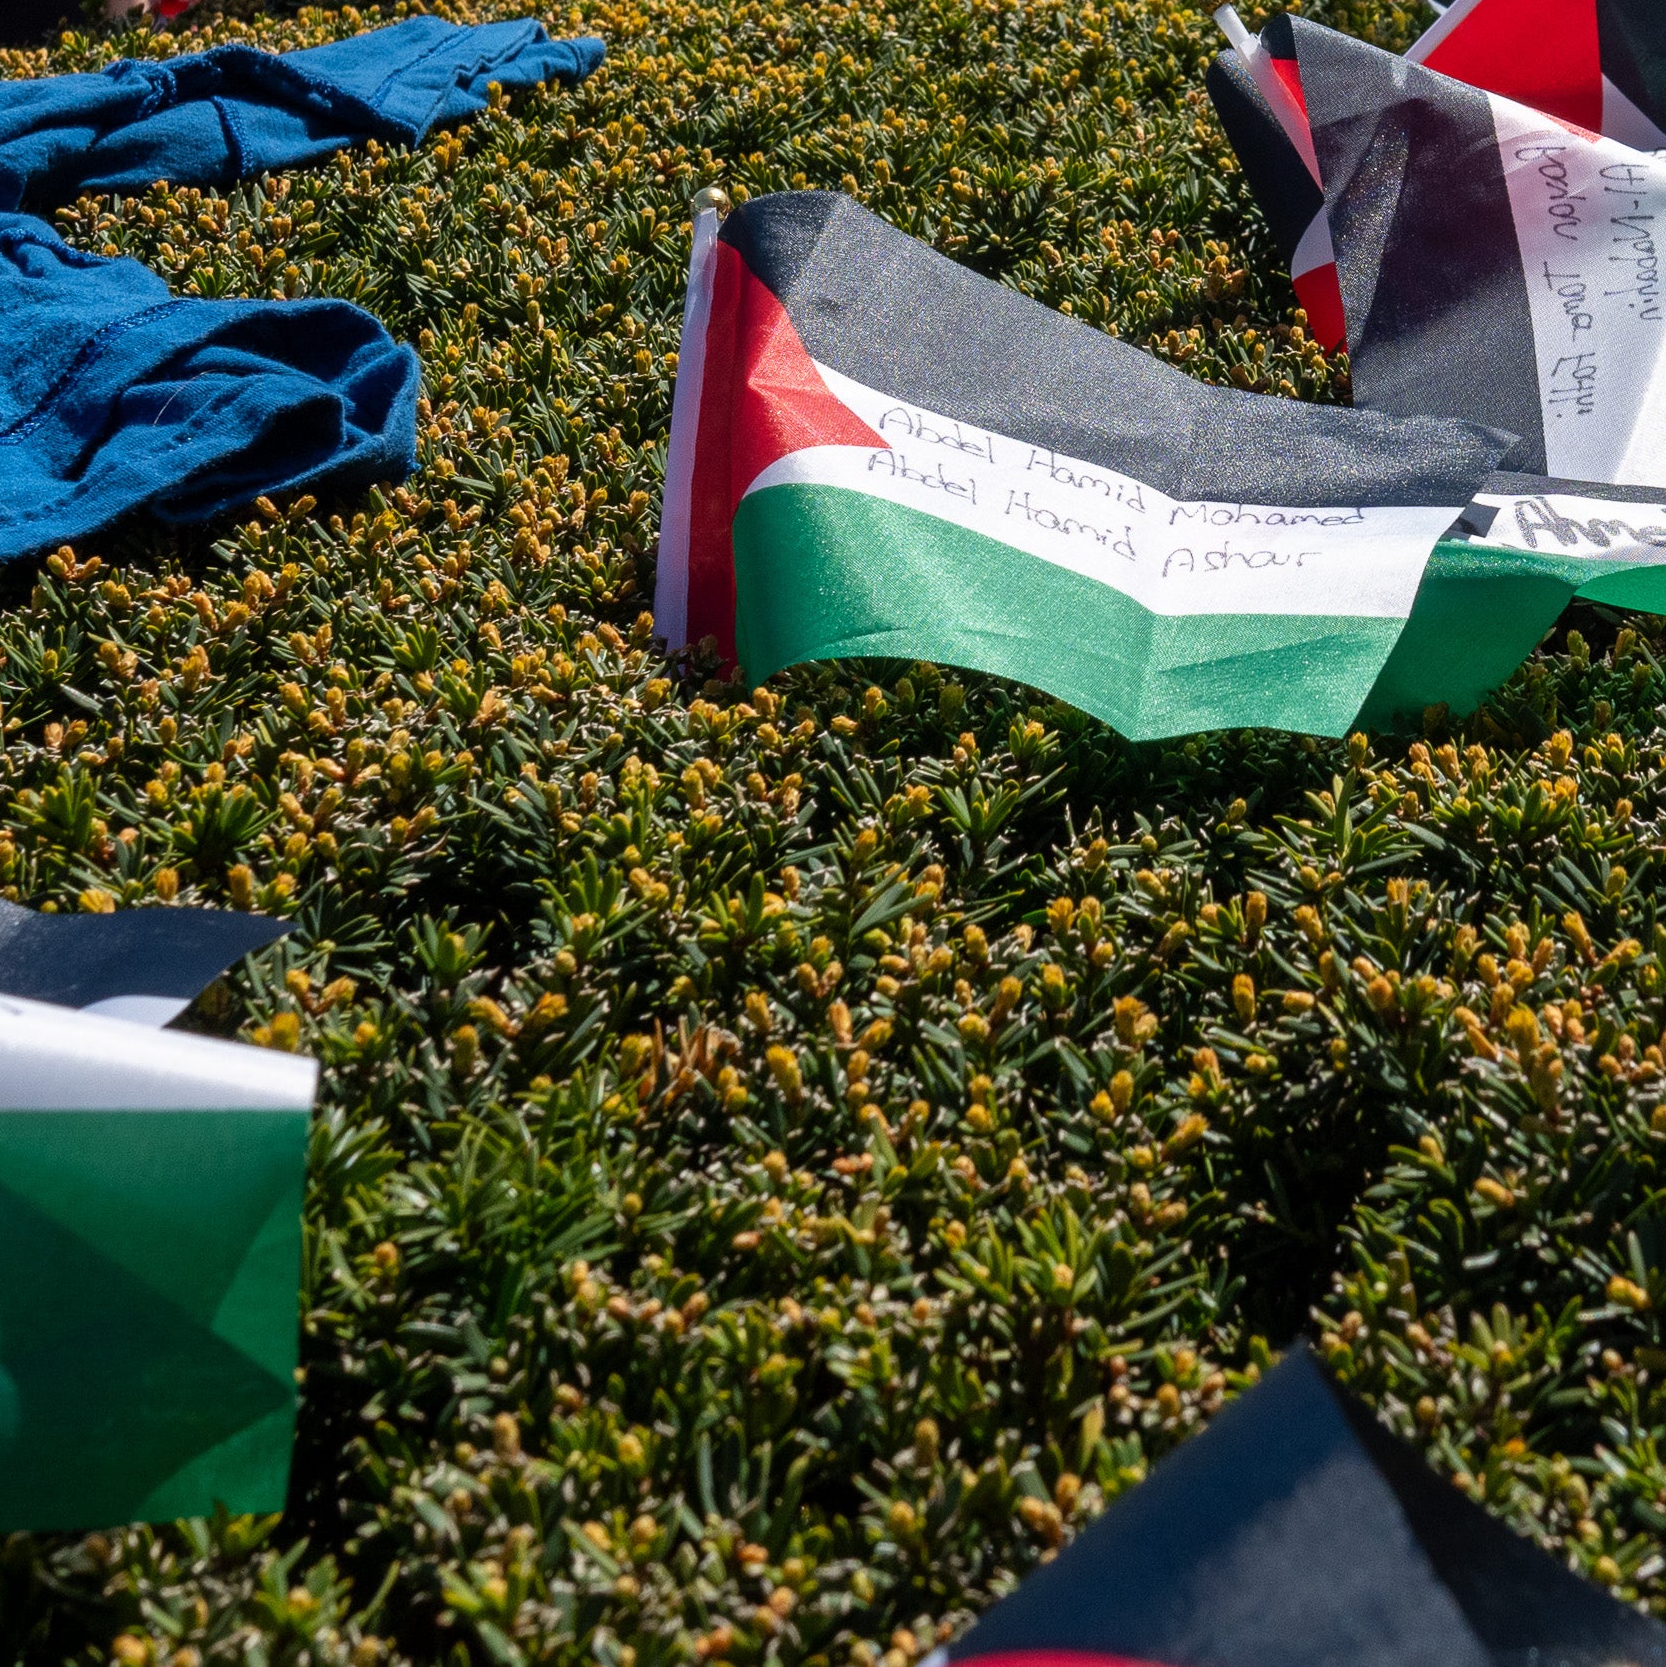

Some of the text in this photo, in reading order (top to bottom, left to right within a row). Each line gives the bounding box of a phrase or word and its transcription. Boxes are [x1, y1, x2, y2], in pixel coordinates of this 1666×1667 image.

[867, 449, 977, 506] Abdel
[1004, 489, 1136, 562] Hamid
[878, 407, 1365, 527] Abdel Hamid Mohamed
